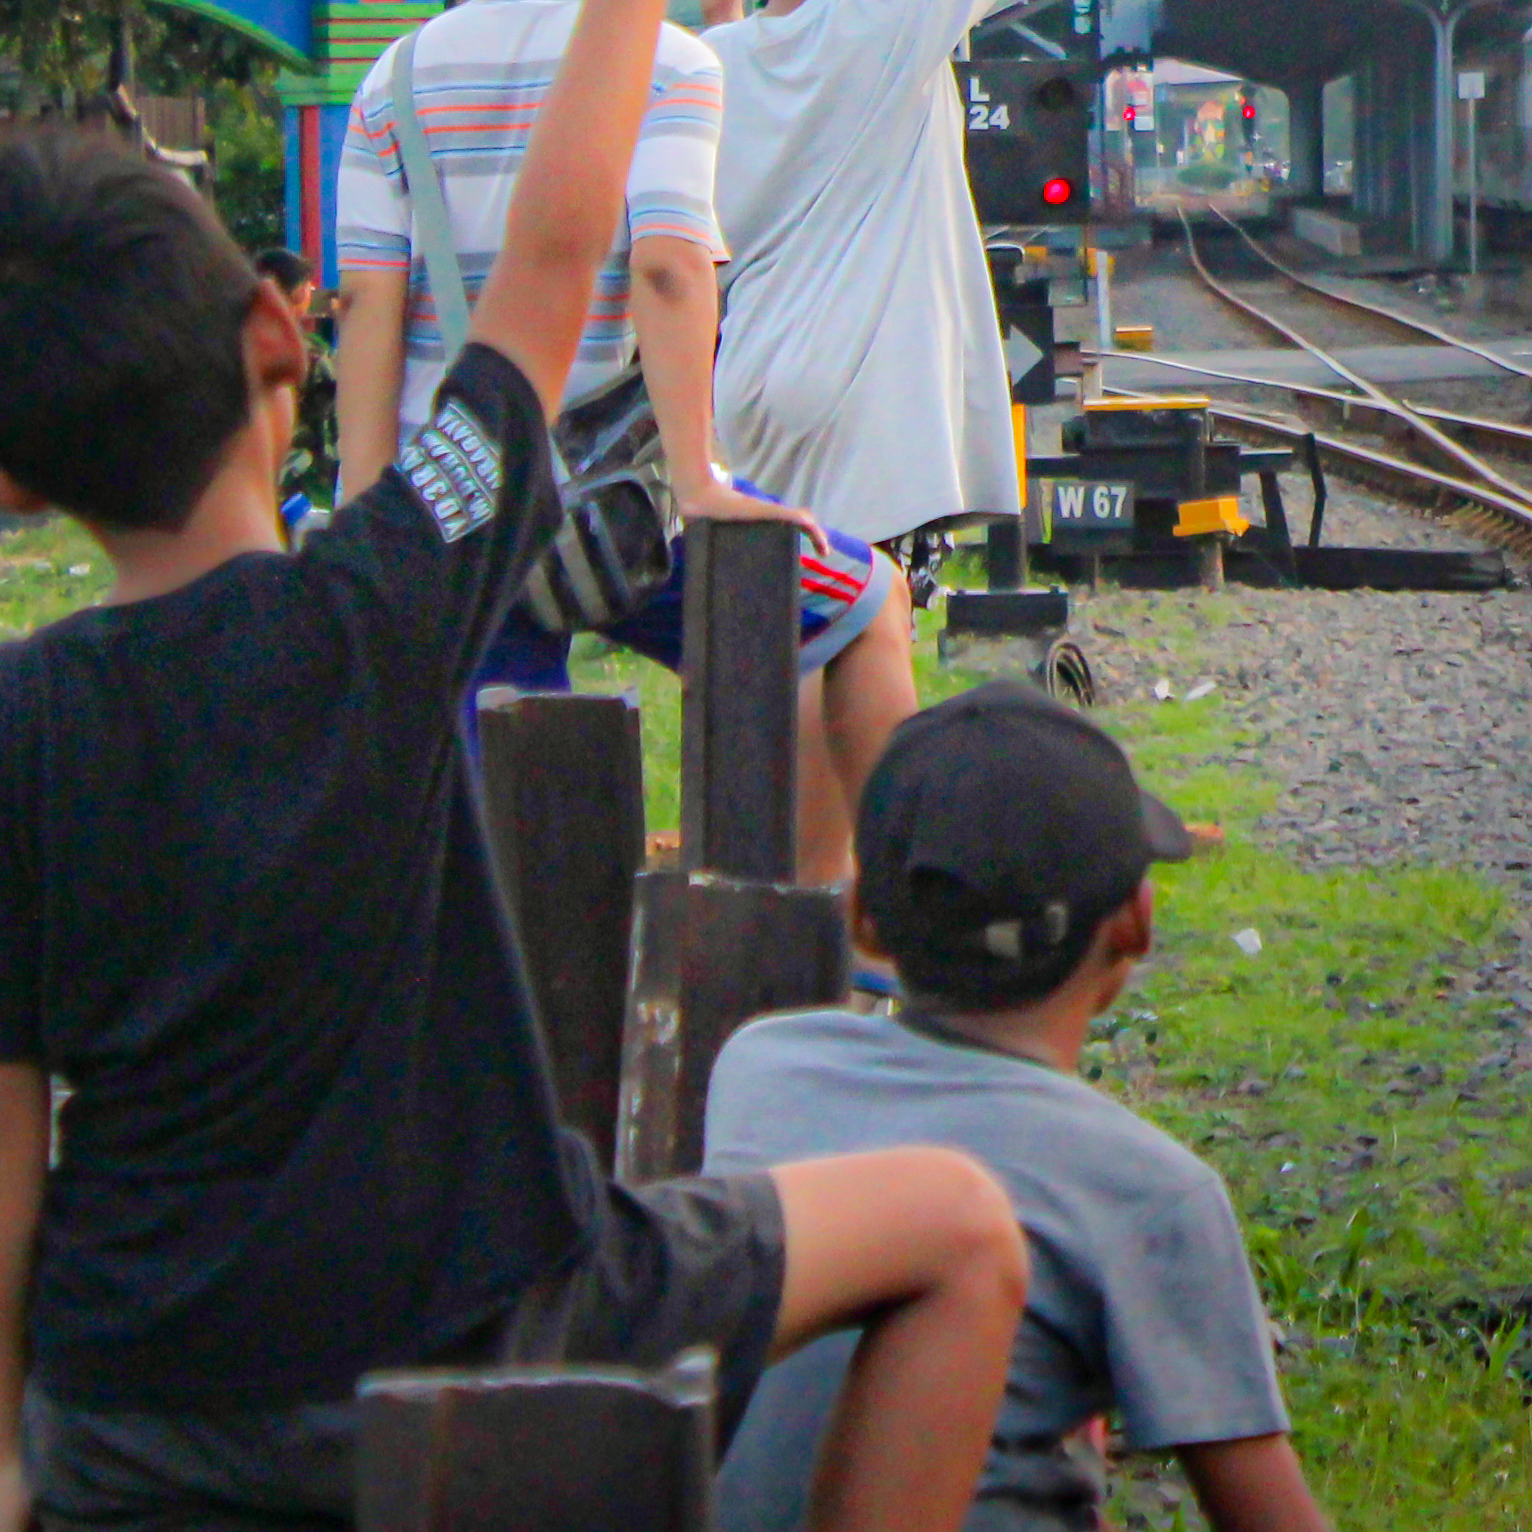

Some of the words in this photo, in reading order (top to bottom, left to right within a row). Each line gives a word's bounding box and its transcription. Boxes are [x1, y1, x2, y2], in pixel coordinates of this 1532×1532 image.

[969, 76, 990, 102] L
[968, 105, 1010, 130] 24
[1058, 486, 1086, 519] W
[1093, 485, 1127, 519] 67
